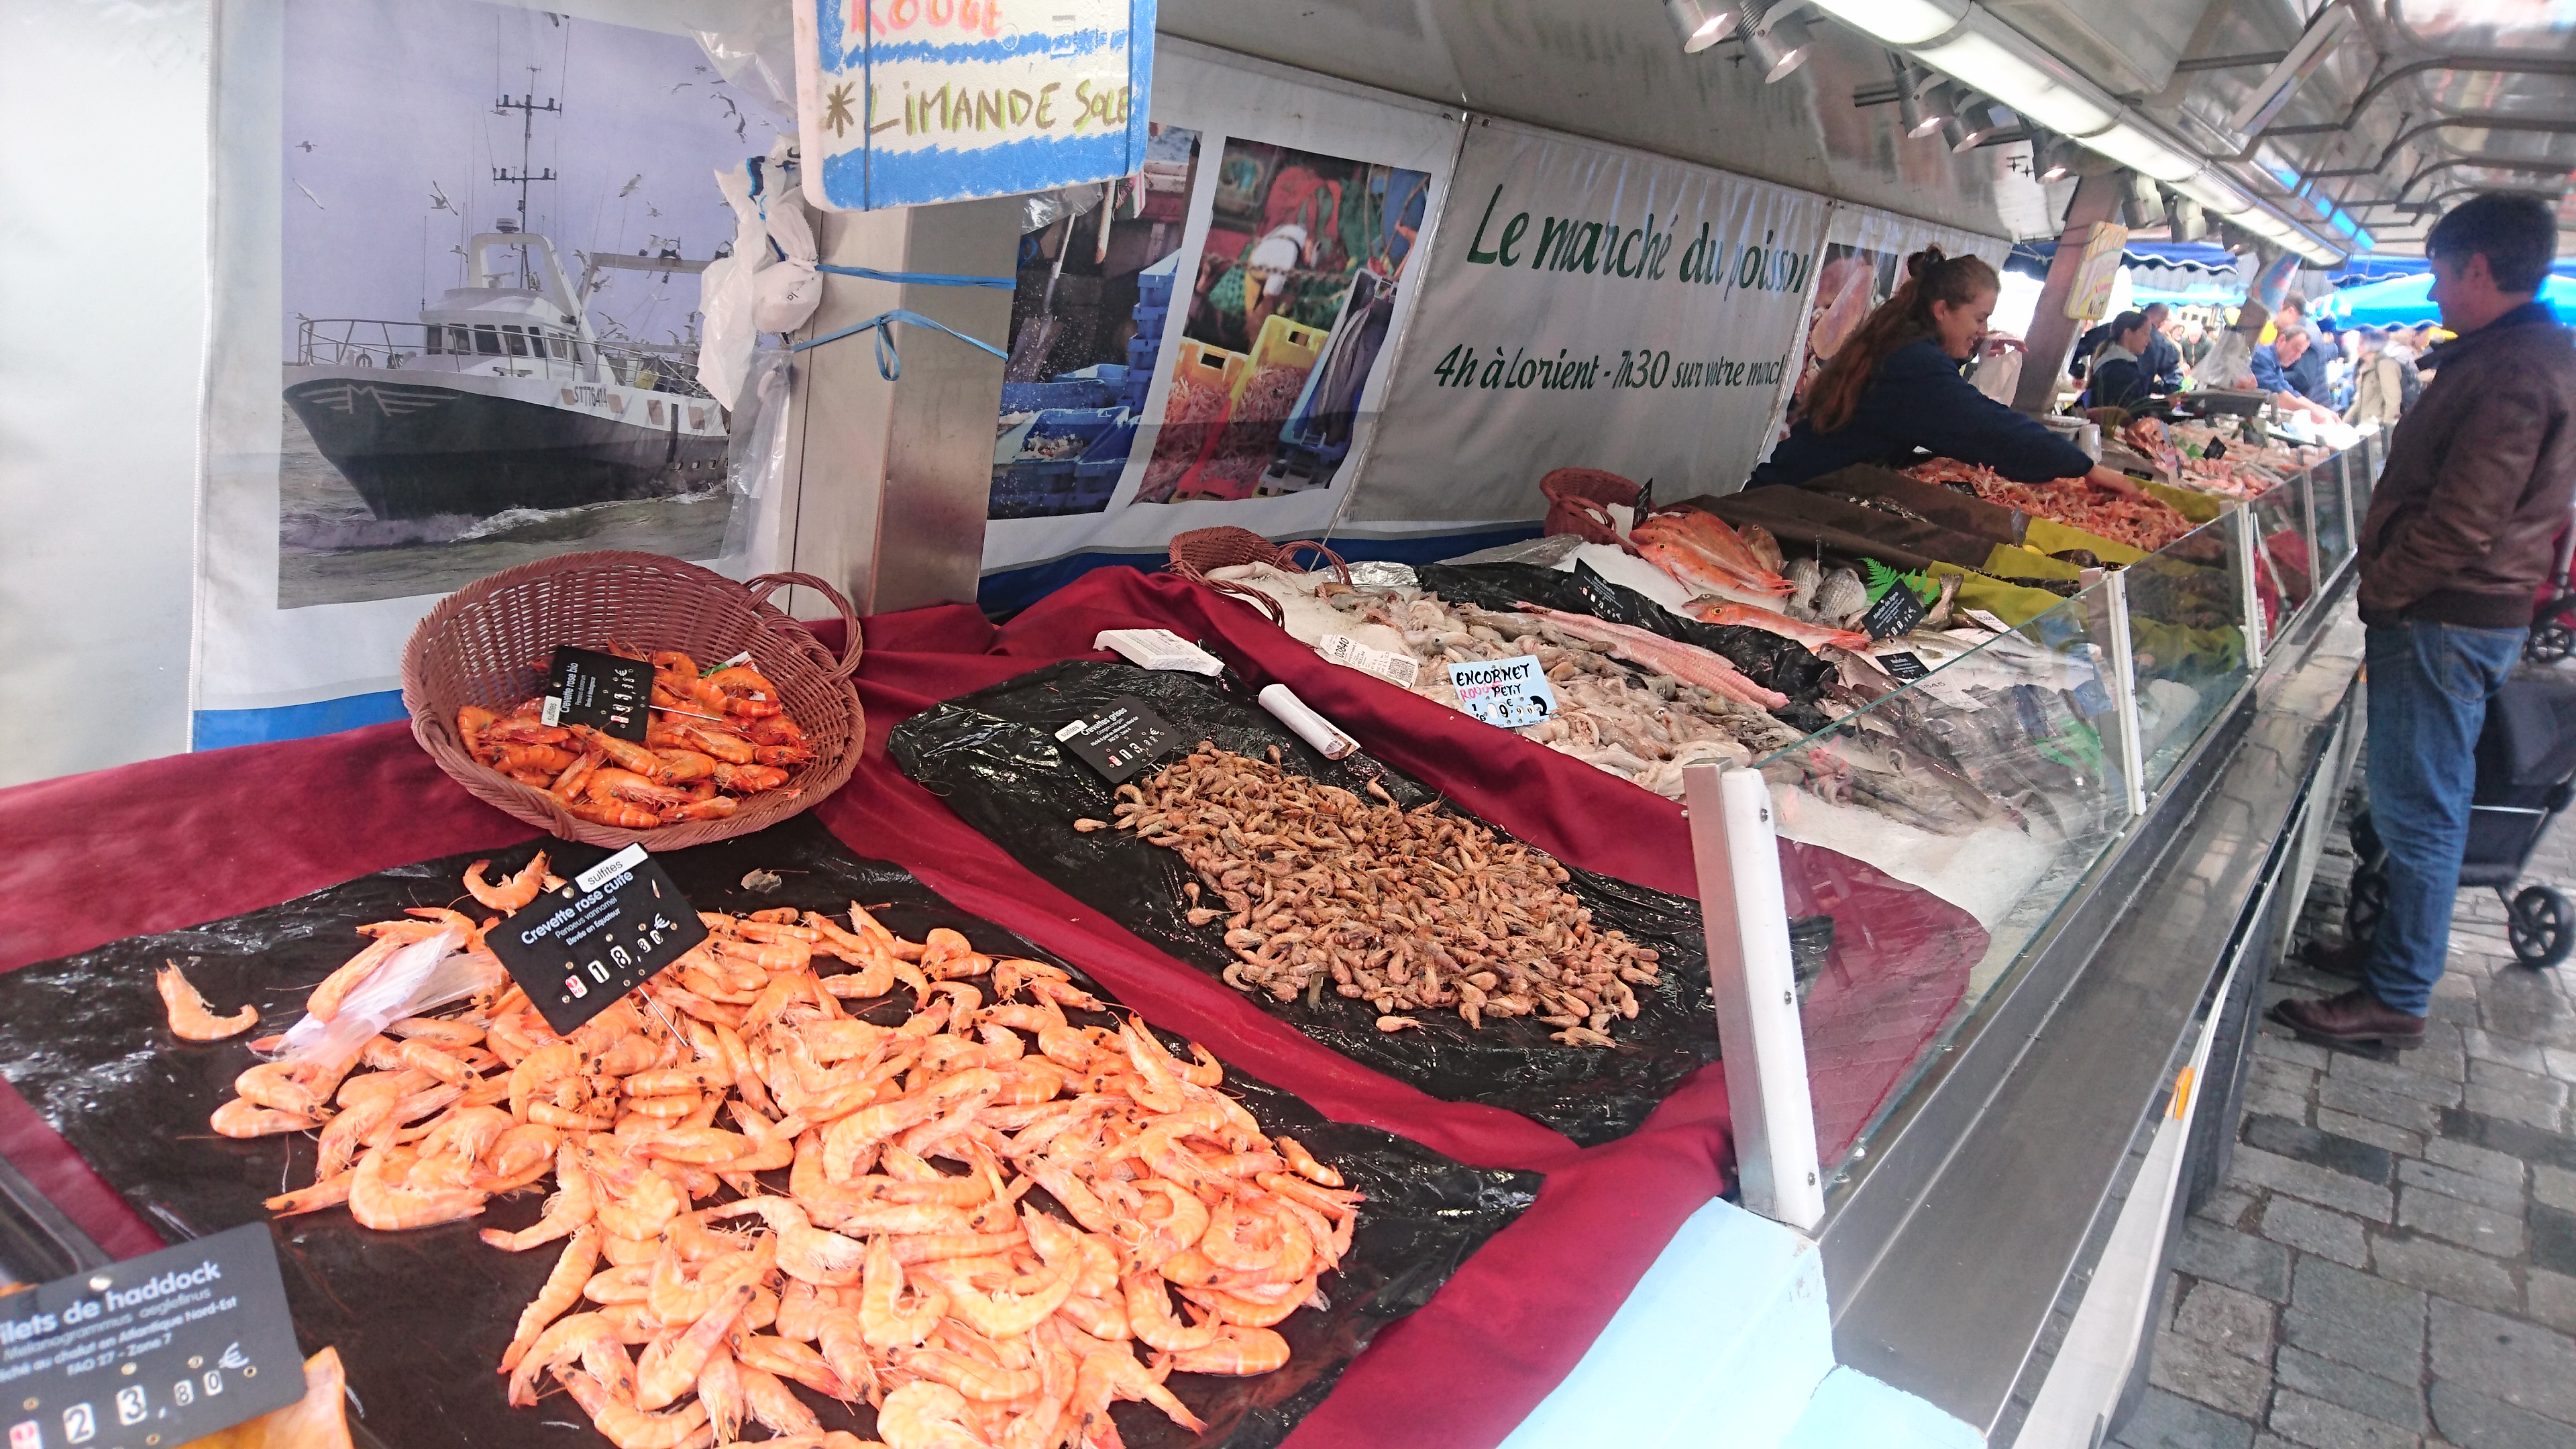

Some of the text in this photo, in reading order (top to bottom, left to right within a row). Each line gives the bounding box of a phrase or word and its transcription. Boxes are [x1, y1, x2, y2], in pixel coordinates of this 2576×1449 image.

[1467, 184, 1529, 267] Le
[1532, 214, 1678, 280] marché
[1680, 222, 1723, 285] du
[1434, 344, 1477, 388] 4h
[1480, 346, 1506, 390] à
[1505, 348, 1599, 390] Lorient
[1611, 350, 1670, 389] 7h30
[1672, 362, 1703, 388] sur
[1333, 637, 1350, 658] 03840
[560, 662, 578, 713] Crevette rose bio
[1456, 663, 1529, 686] ENCORNET
[1061, 724, 1080, 738] sulfites
[1081, 708, 1128, 736] Crevettes grises
[588, 860, 623, 885] sulfites
[521, 871, 634, 945] Crevette rose cuite
[555, 896, 619, 939] Penaeus vannamei
[0, 1260, 221, 1344] ilets de haddock
